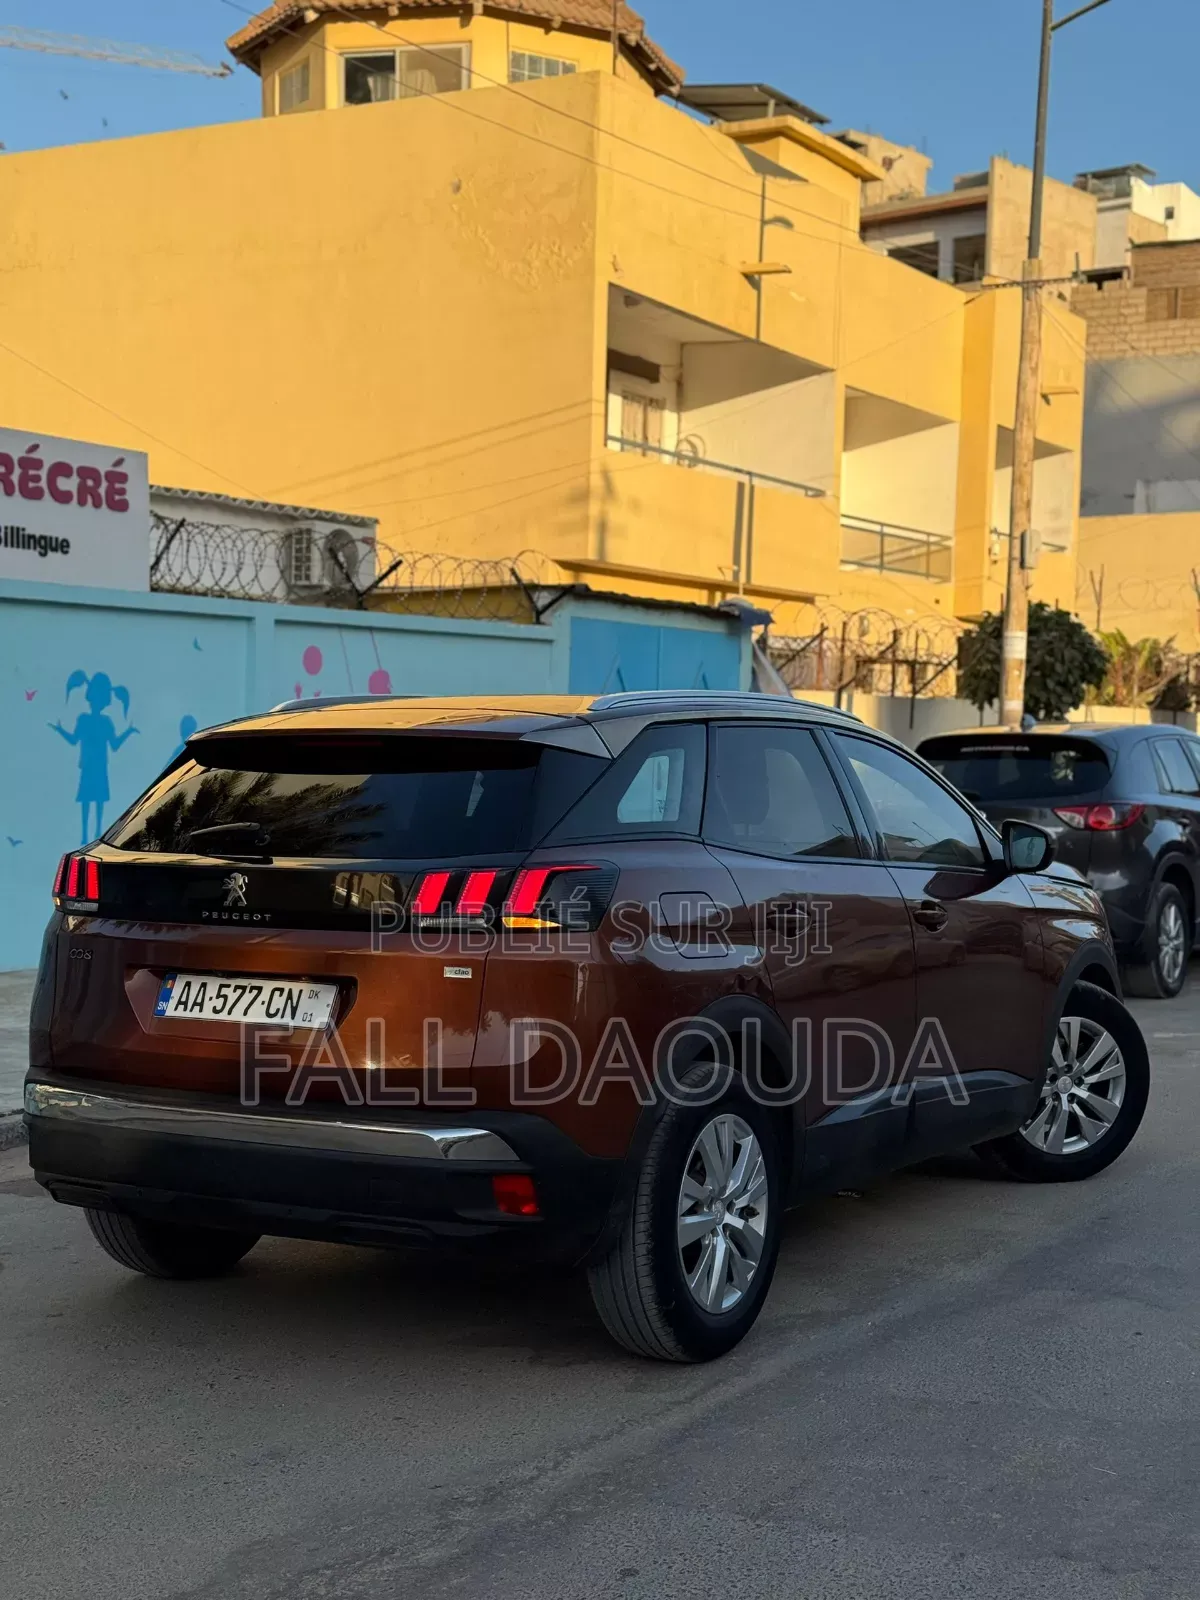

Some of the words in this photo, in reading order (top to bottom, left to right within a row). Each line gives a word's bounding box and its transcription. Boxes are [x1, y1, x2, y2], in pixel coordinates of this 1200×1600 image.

[0, 525, 70, 557] illingue
[202, 911, 272, 922] PEUGEOT
[307, 989, 320, 1000] DK
[157, 1001, 168, 1011] SN
[301, 1012, 314, 1023] 01
